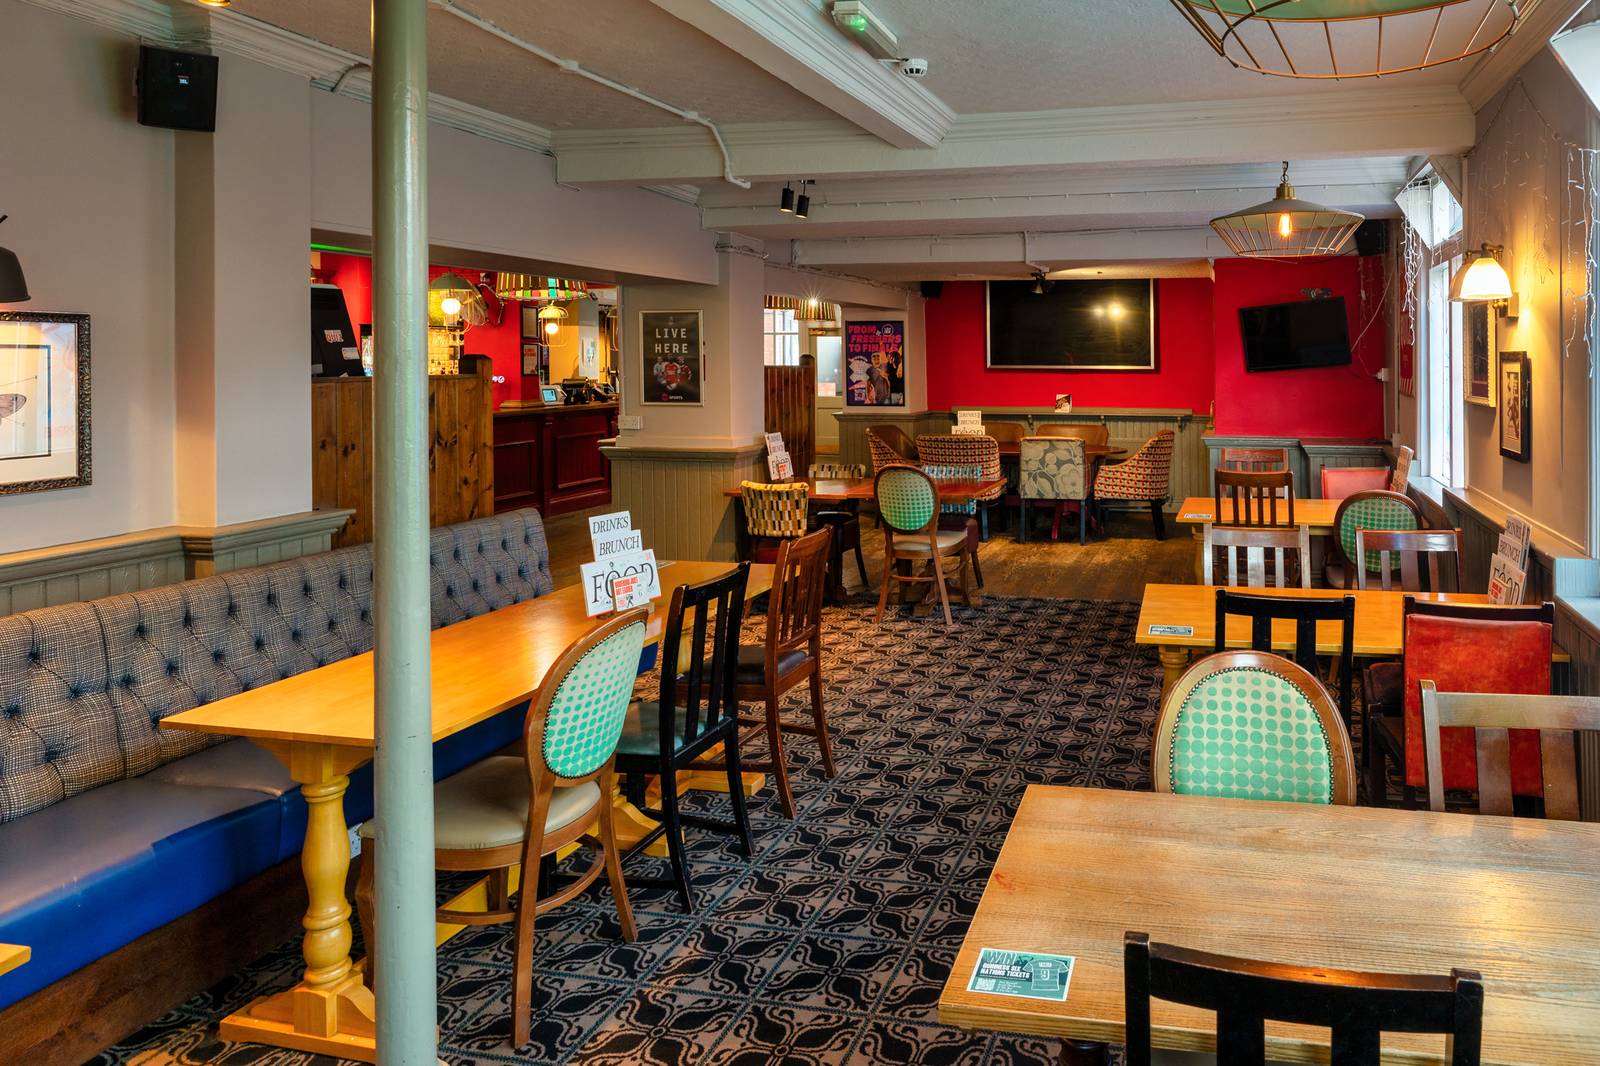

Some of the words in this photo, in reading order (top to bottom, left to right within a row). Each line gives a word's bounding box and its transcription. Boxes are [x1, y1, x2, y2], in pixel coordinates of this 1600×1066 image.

[655, 328, 687, 339] LIVE
[848, 325, 877, 334] FROM
[850, 335, 902, 343] FRESHERS
[655, 343, 689, 354] HERE
[848, 344, 861, 353] TO
[862, 343, 899, 353] FINALS
[592, 515, 629, 534] DRINKS
[599, 535, 640, 556] BRUNCH
[986, 950, 1017, 965] WIN
[980, 968, 1006, 977] NATIONS
[1006, 970, 1030, 979] TICKETS
